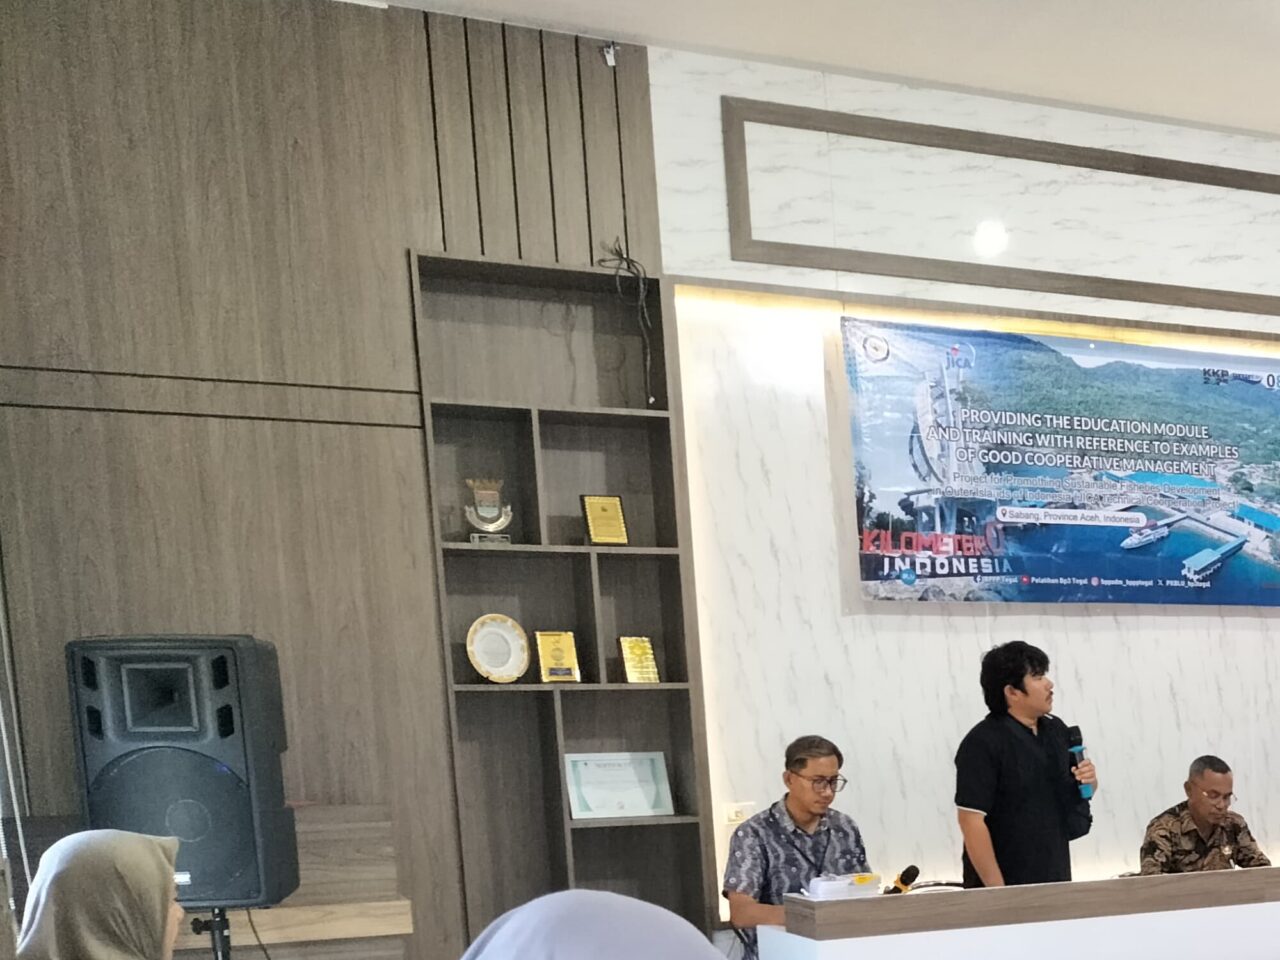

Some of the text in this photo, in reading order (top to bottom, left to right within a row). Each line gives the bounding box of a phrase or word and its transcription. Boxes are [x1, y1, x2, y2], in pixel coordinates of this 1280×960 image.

[961, 409, 1209, 438] PROVIDING THE EDUCATION MODULE
[927, 426, 1239, 459] AND TRAINING WITH REFERENCE TO EXAMPLES
[956, 448, 1216, 476] OF GOOD COOPERATIVE MANAGEMENT
[953, 472, 988, 486] Project
[1063, 478, 1117, 490] Sustainable
[1163, 484, 1221, 496] Development
[1008, 511, 1140, 524] Sabang, Province Aceh, Indonesia
[883, 557, 1013, 576] INDONESIA
